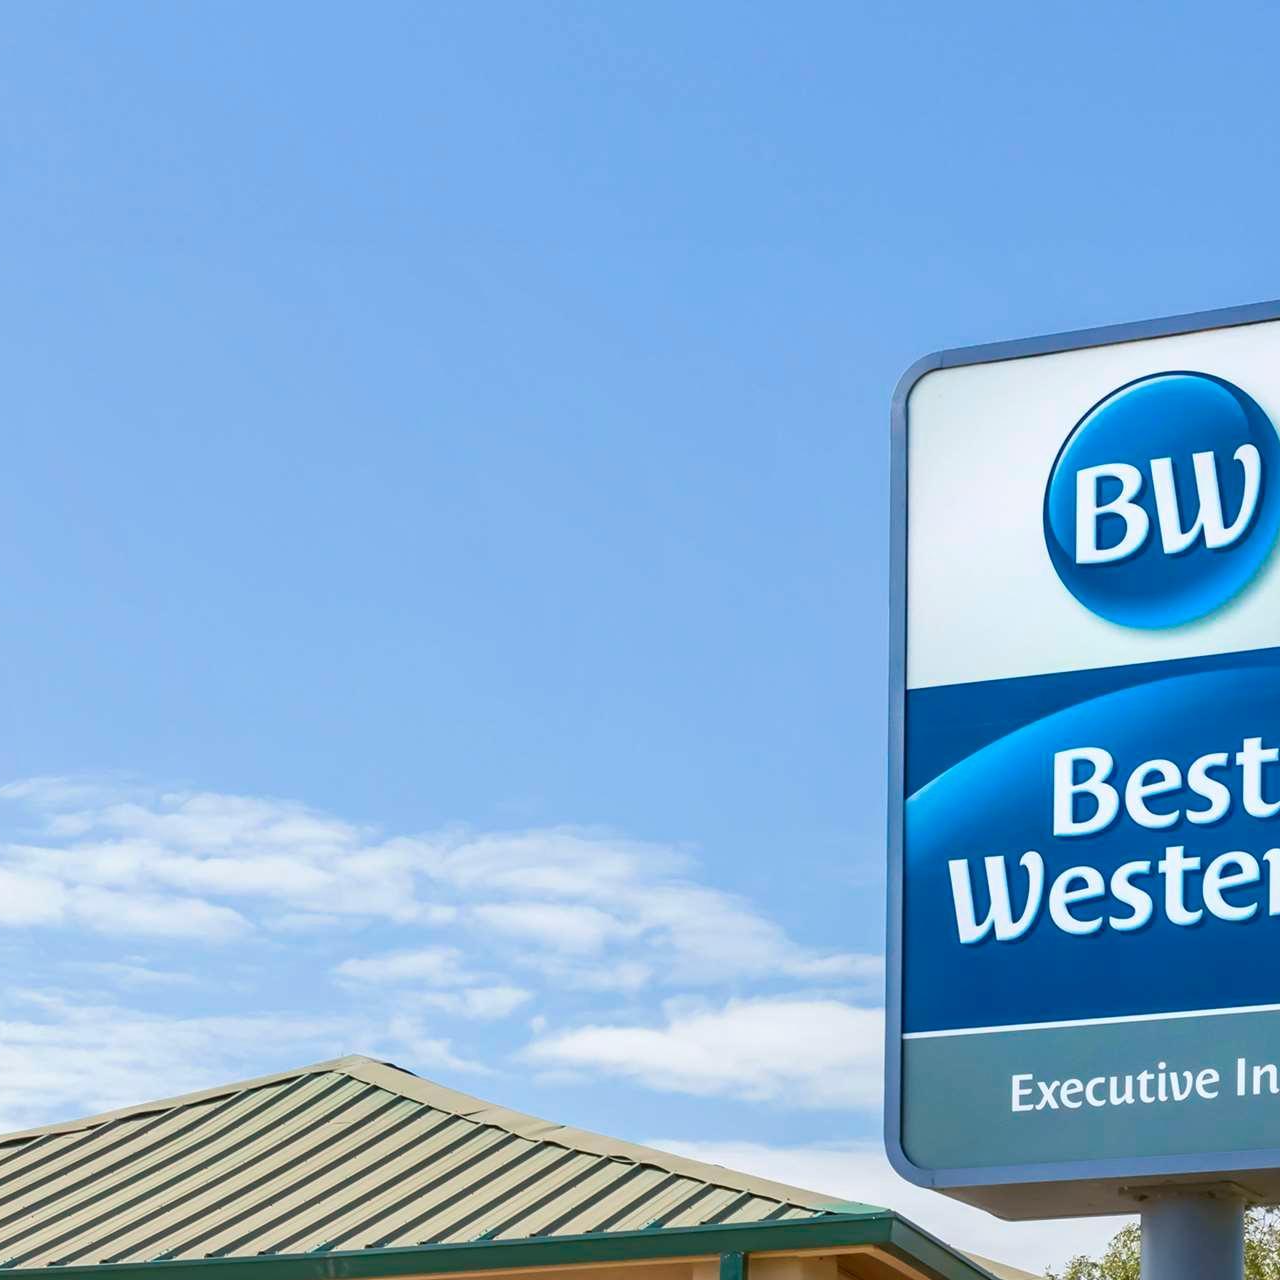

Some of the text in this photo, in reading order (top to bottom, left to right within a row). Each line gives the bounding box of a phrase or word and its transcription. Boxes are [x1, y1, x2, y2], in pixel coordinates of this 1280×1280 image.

[1075, 443, 1262, 566] BW
[1053, 737, 1280, 836] Best
[1011, 1061, 1220, 1112] Executive
